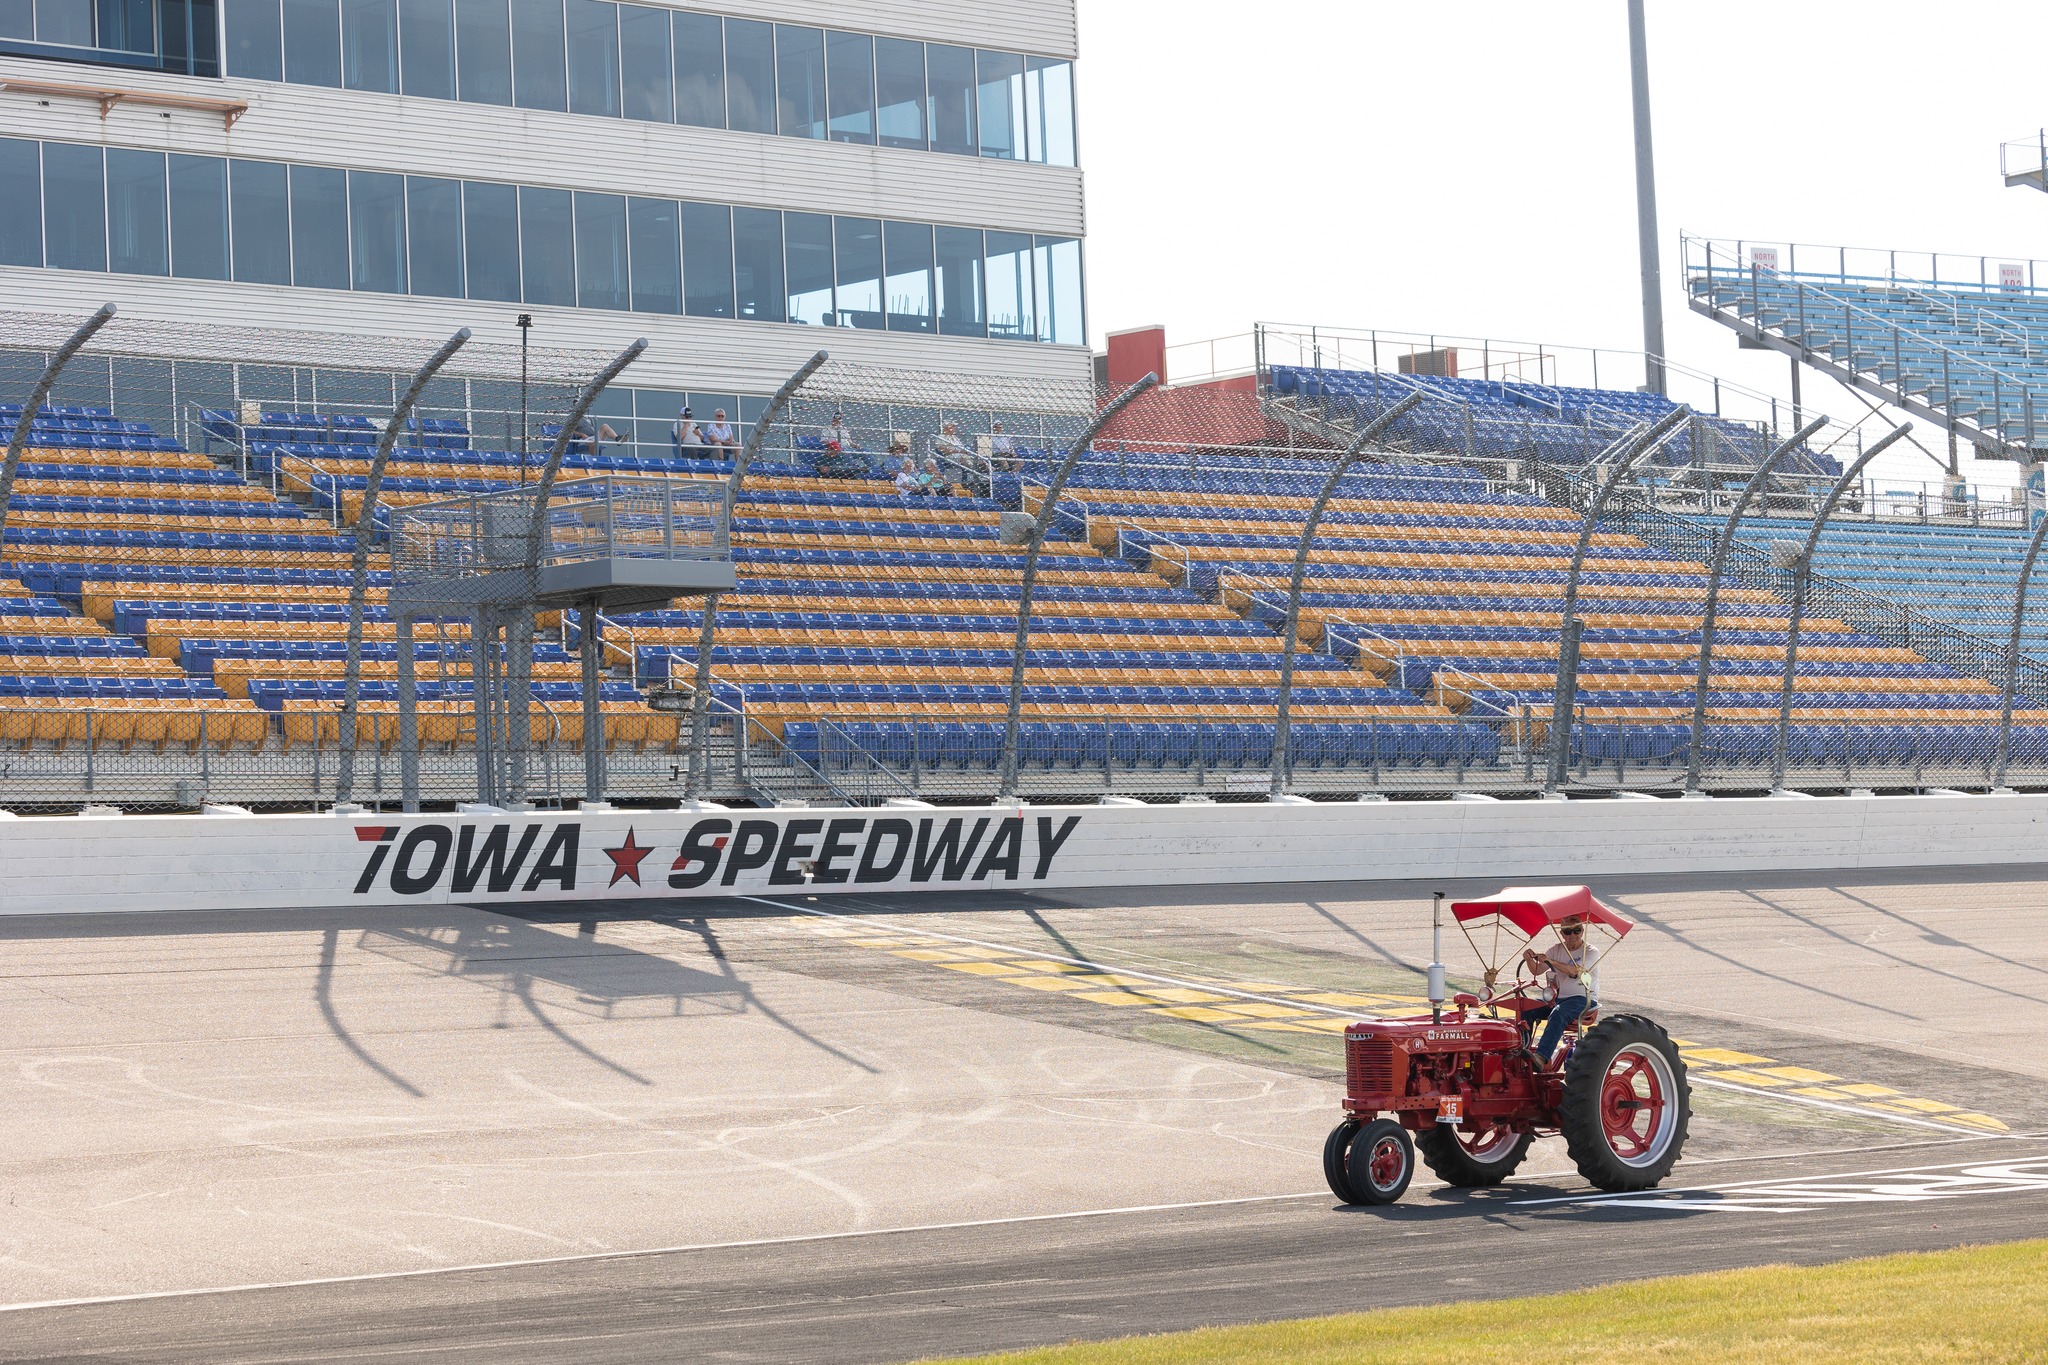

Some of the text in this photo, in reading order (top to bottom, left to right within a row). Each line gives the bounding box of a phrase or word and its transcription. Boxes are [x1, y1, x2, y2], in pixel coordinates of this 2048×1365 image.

[1754, 253, 1775, 261] NORTH
[2001, 269, 2022, 277] NORTH
[354, 816, 1082, 895] IOWA SPEEDWAY
[1436, 1032, 1469, 1040] FARMALL
[1445, 1103, 1457, 1114] 15
